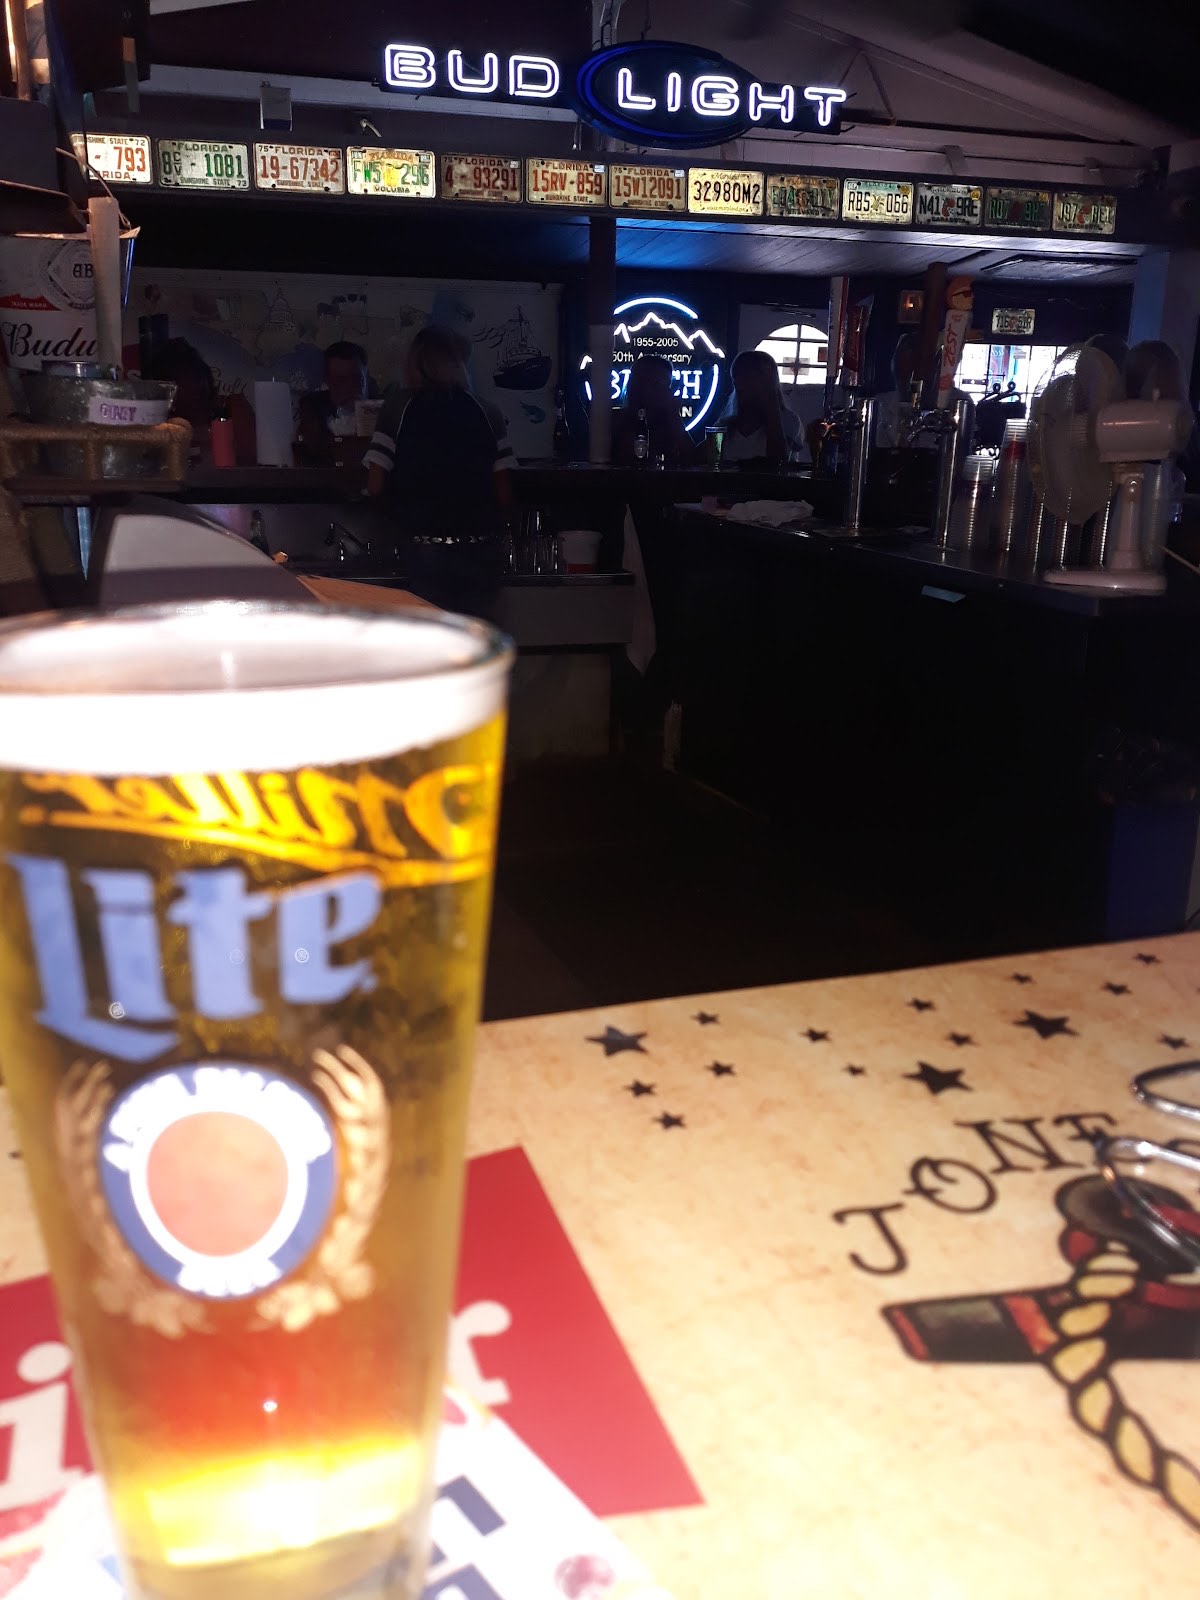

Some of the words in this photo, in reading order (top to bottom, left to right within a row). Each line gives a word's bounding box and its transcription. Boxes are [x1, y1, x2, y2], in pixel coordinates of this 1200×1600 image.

[384, 43, 561, 98] BUD
[616, 67, 848, 126] LIGHT
[109, 137, 128, 145] STATE
[134, 138, 146, 146] 72
[177, 142, 228, 152] FLORIDA
[275, 146, 324, 156] FLORIDA
[204, 153, 245, 178] 1081
[458, 157, 503, 167] FLORIDA
[545, 161, 589, 171] FLORIDA
[260, 155, 339, 182] 19-67342
[627, 167, 670, 177] FLORIDA
[212, 178, 230, 186] STATE
[236, 179, 247, 187] 73
[532, 169, 603, 195] 15RV-859
[614, 175, 682, 200] 15W12091
[693, 180, 761, 204] 32980M2
[545, 194, 571, 202] SUNSHINE
[632, 337, 679, 347] 1955-2005
[5, 852, 385, 1063] Lite
